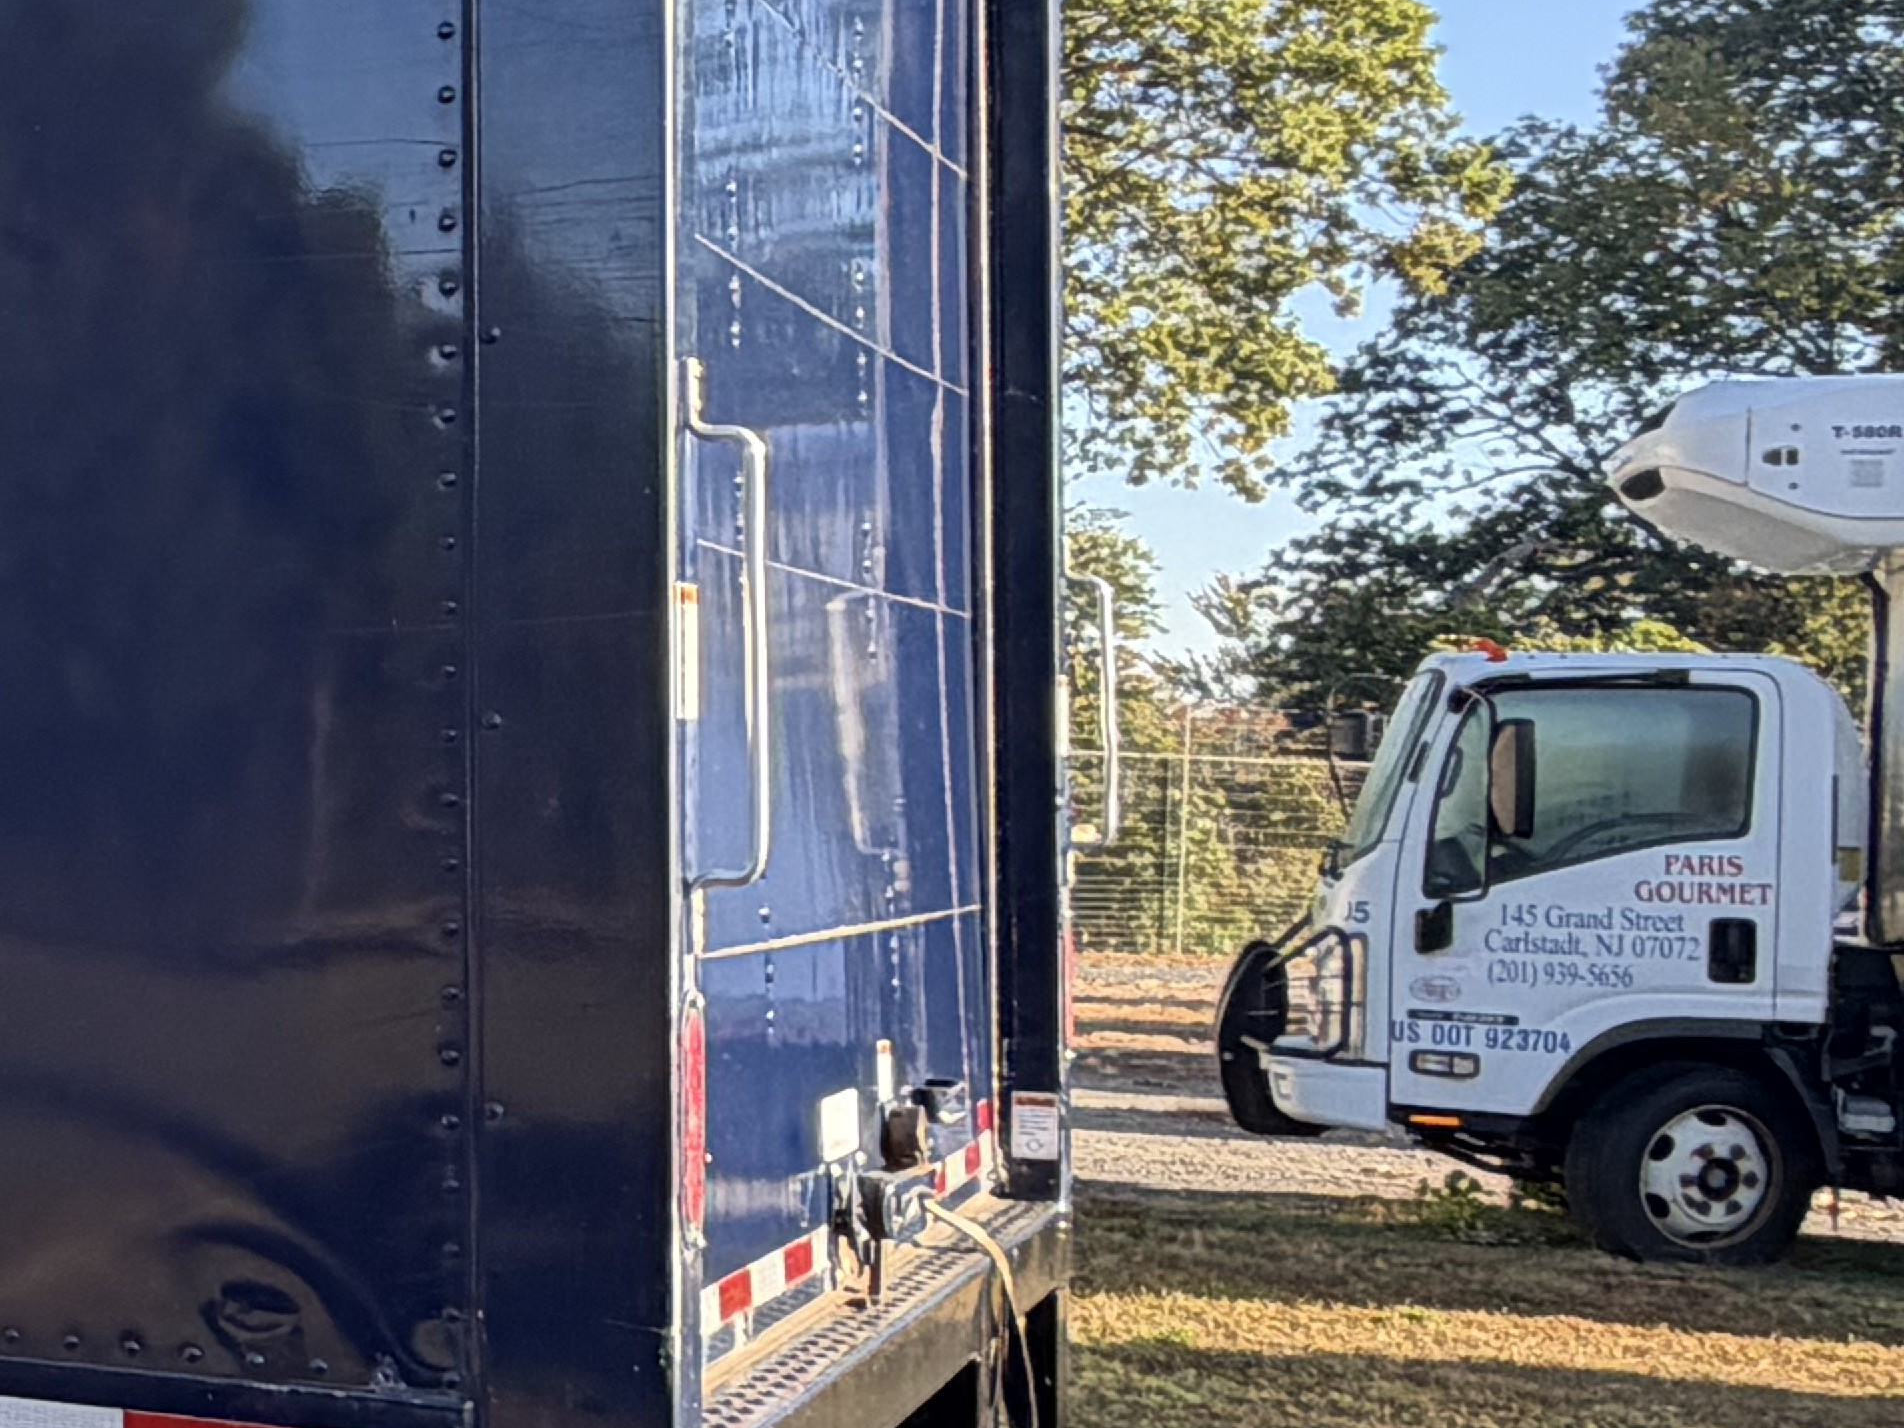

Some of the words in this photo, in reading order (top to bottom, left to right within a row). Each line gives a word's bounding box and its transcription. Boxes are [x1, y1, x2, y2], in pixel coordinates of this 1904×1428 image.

[1664, 854, 1744, 877] PARIS
[1634, 880, 1773, 905] GOURMET
[1500, 903, 1538, 927] 145
[1545, 905, 1614, 931] Grand
[1620, 907, 1685, 933] Street
[1484, 929, 1588, 958] Carlstadt,
[1596, 934, 1625, 958] NJ
[1632, 936, 1701, 962] 07072
[1487, 959, 1538, 988] (201)
[1544, 962, 1634, 988] 939-5656
[1392, 1021, 1420, 1044] US
[1432, 1024, 1475, 1047] DOT
[1485, 1028, 1571, 1053] 923704
